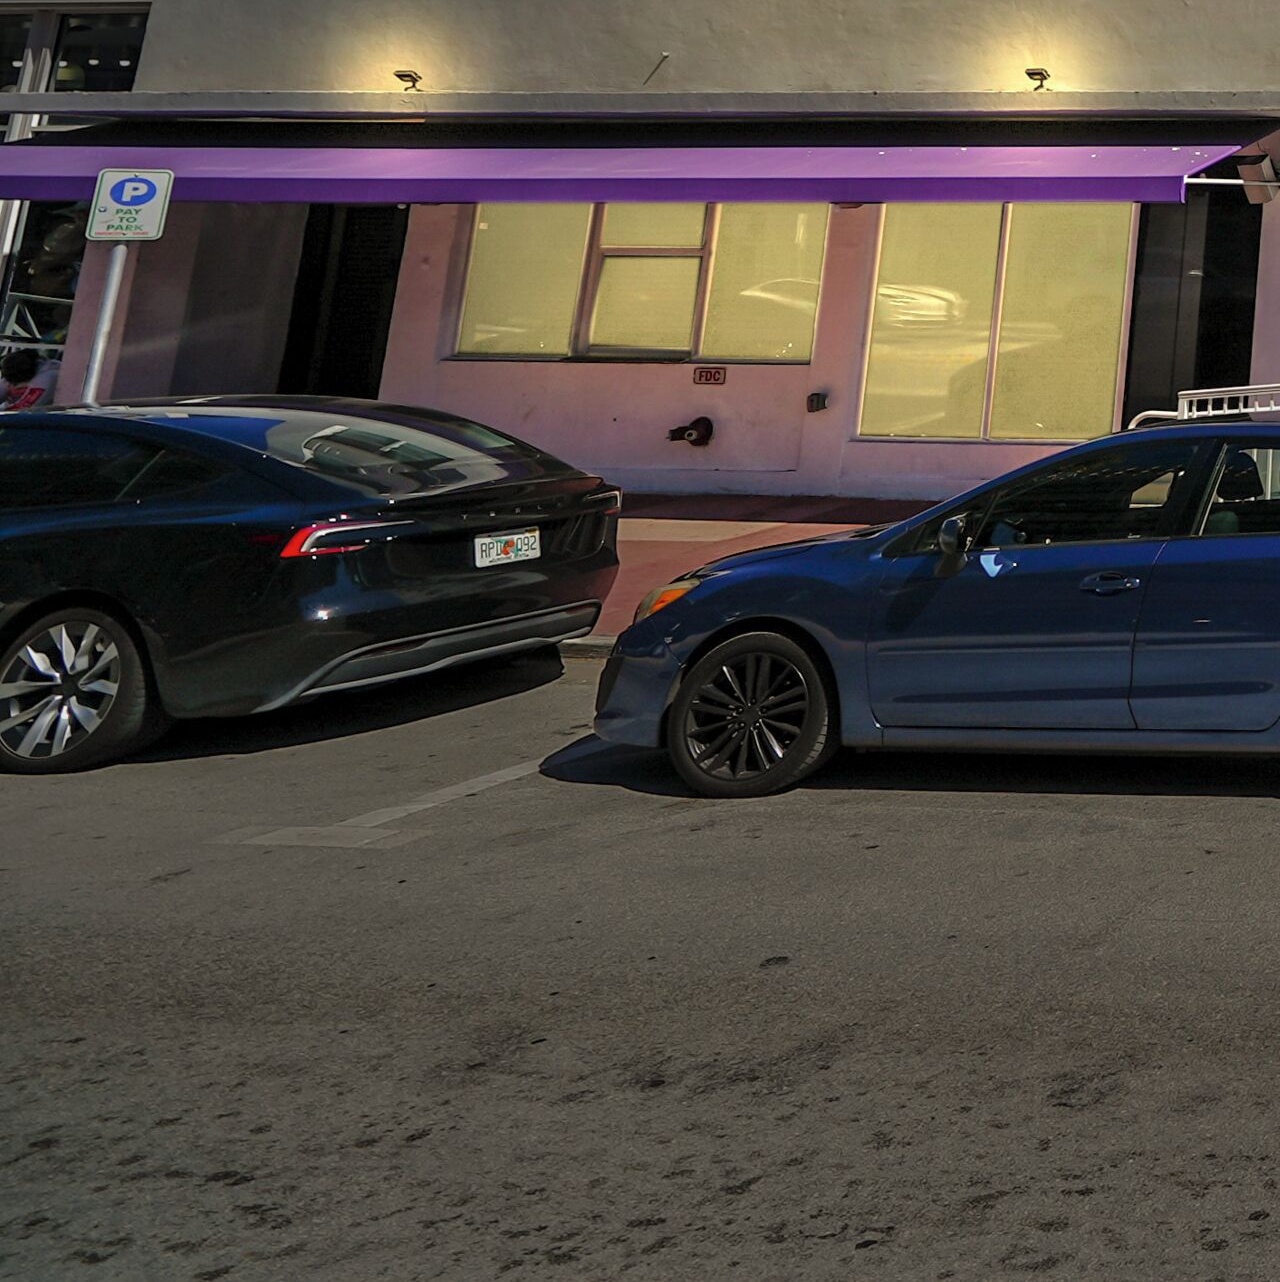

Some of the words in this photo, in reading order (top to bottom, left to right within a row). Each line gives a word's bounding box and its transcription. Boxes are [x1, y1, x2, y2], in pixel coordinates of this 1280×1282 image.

[121, 182, 149, 202] P
[115, 208, 142, 216] PAY
[118, 216, 137, 224] TO
[106, 224, 144, 232] PARK
[698, 370, 721, 382] FDC
